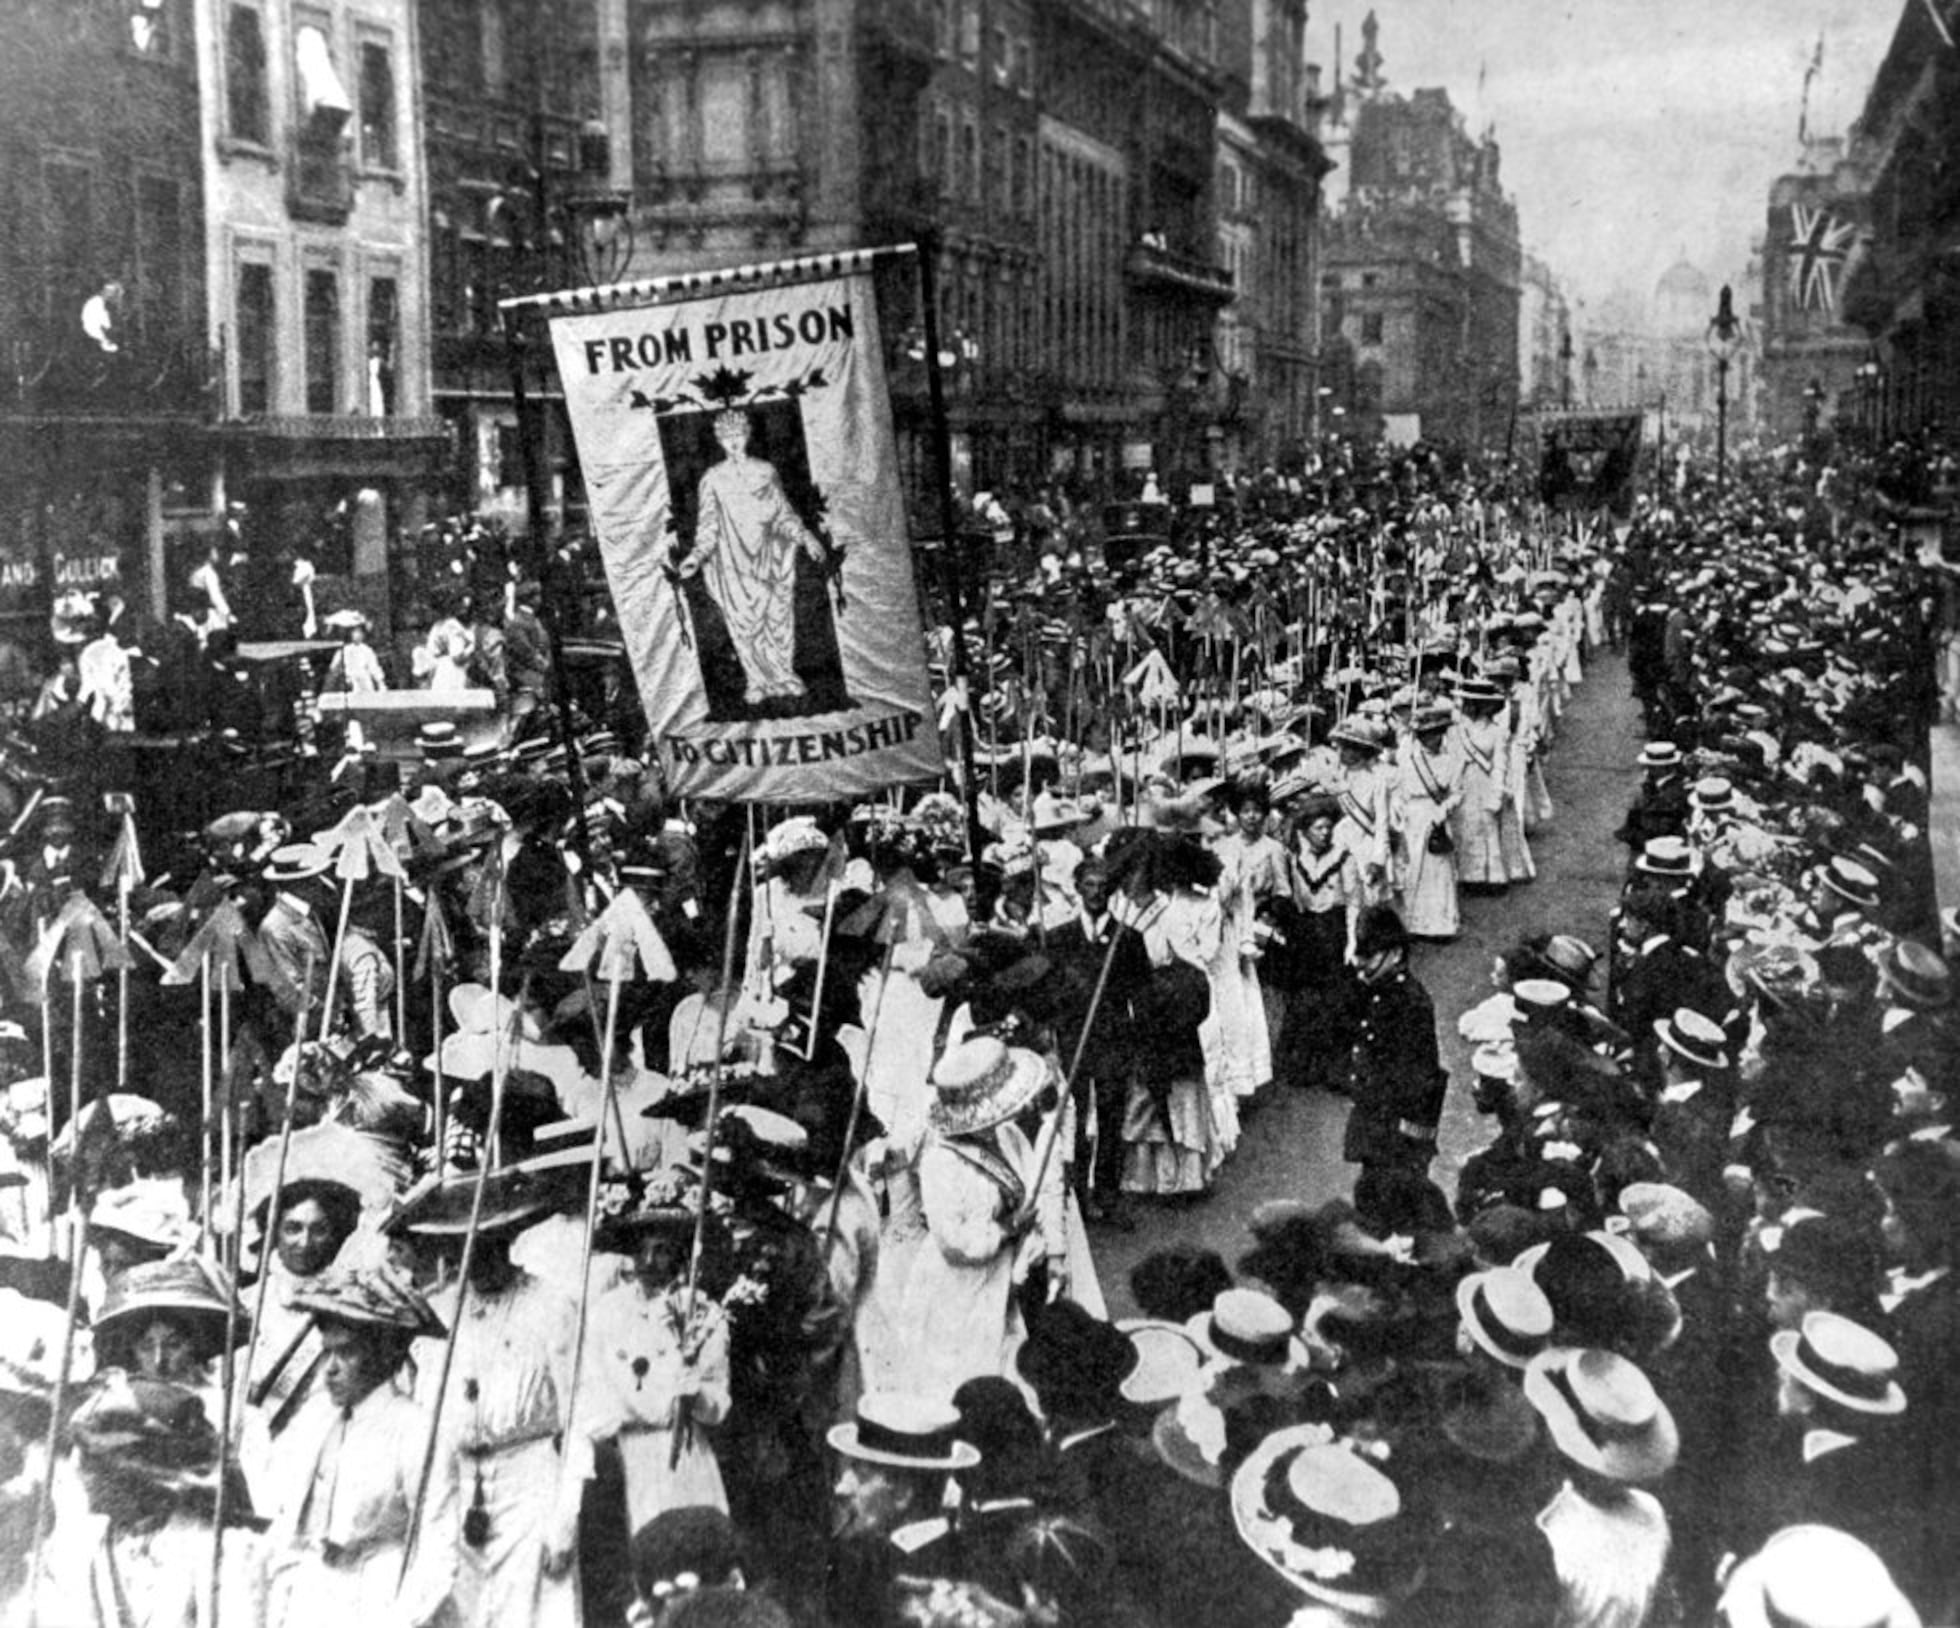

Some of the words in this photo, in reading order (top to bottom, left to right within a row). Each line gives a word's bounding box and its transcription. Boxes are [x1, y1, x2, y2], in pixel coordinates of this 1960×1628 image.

[585, 327, 692, 374] FROM
[705, 304, 854, 359] PRISON
[705, 712, 921, 766] CITIZENSHIP
